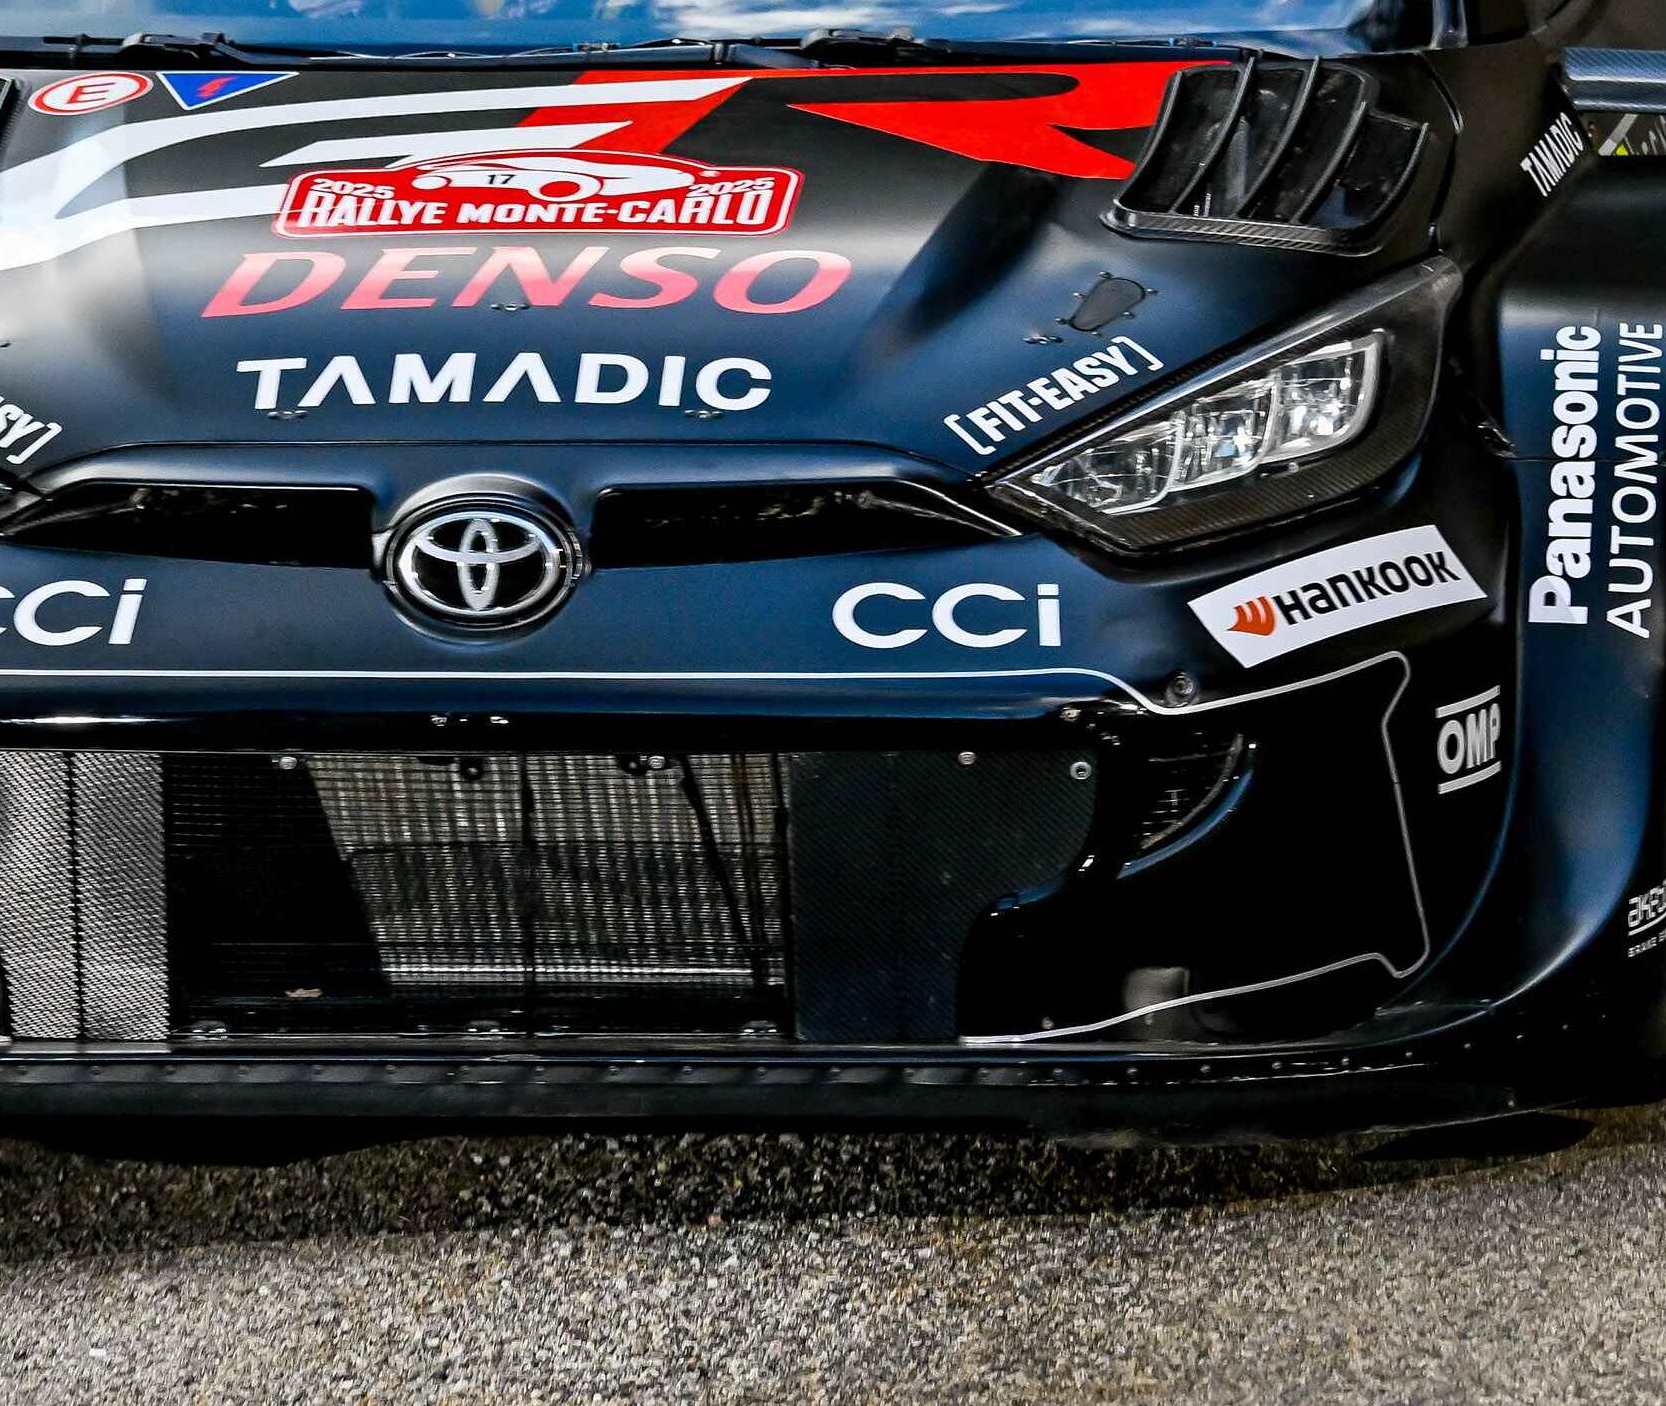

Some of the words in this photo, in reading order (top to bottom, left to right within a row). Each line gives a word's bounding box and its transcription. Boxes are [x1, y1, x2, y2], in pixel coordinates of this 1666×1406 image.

[487, 175, 516, 185] 17
[1519, 112, 1584, 197] TAMADIC
[297, 192, 447, 227] RALLYE
[456, 190, 773, 224] MONTE-CARLO
[312, 178, 395, 200] 2025
[686, 177, 774, 199] 2025
[200, 247, 853, 318] DENSO
[236, 351, 772, 410] TAMADIC
[1528, 324, 1602, 625] Panasonic
[1606, 322, 1664, 639] AUTOMOTIVE
[1437, 704, 1502, 775] OMP
